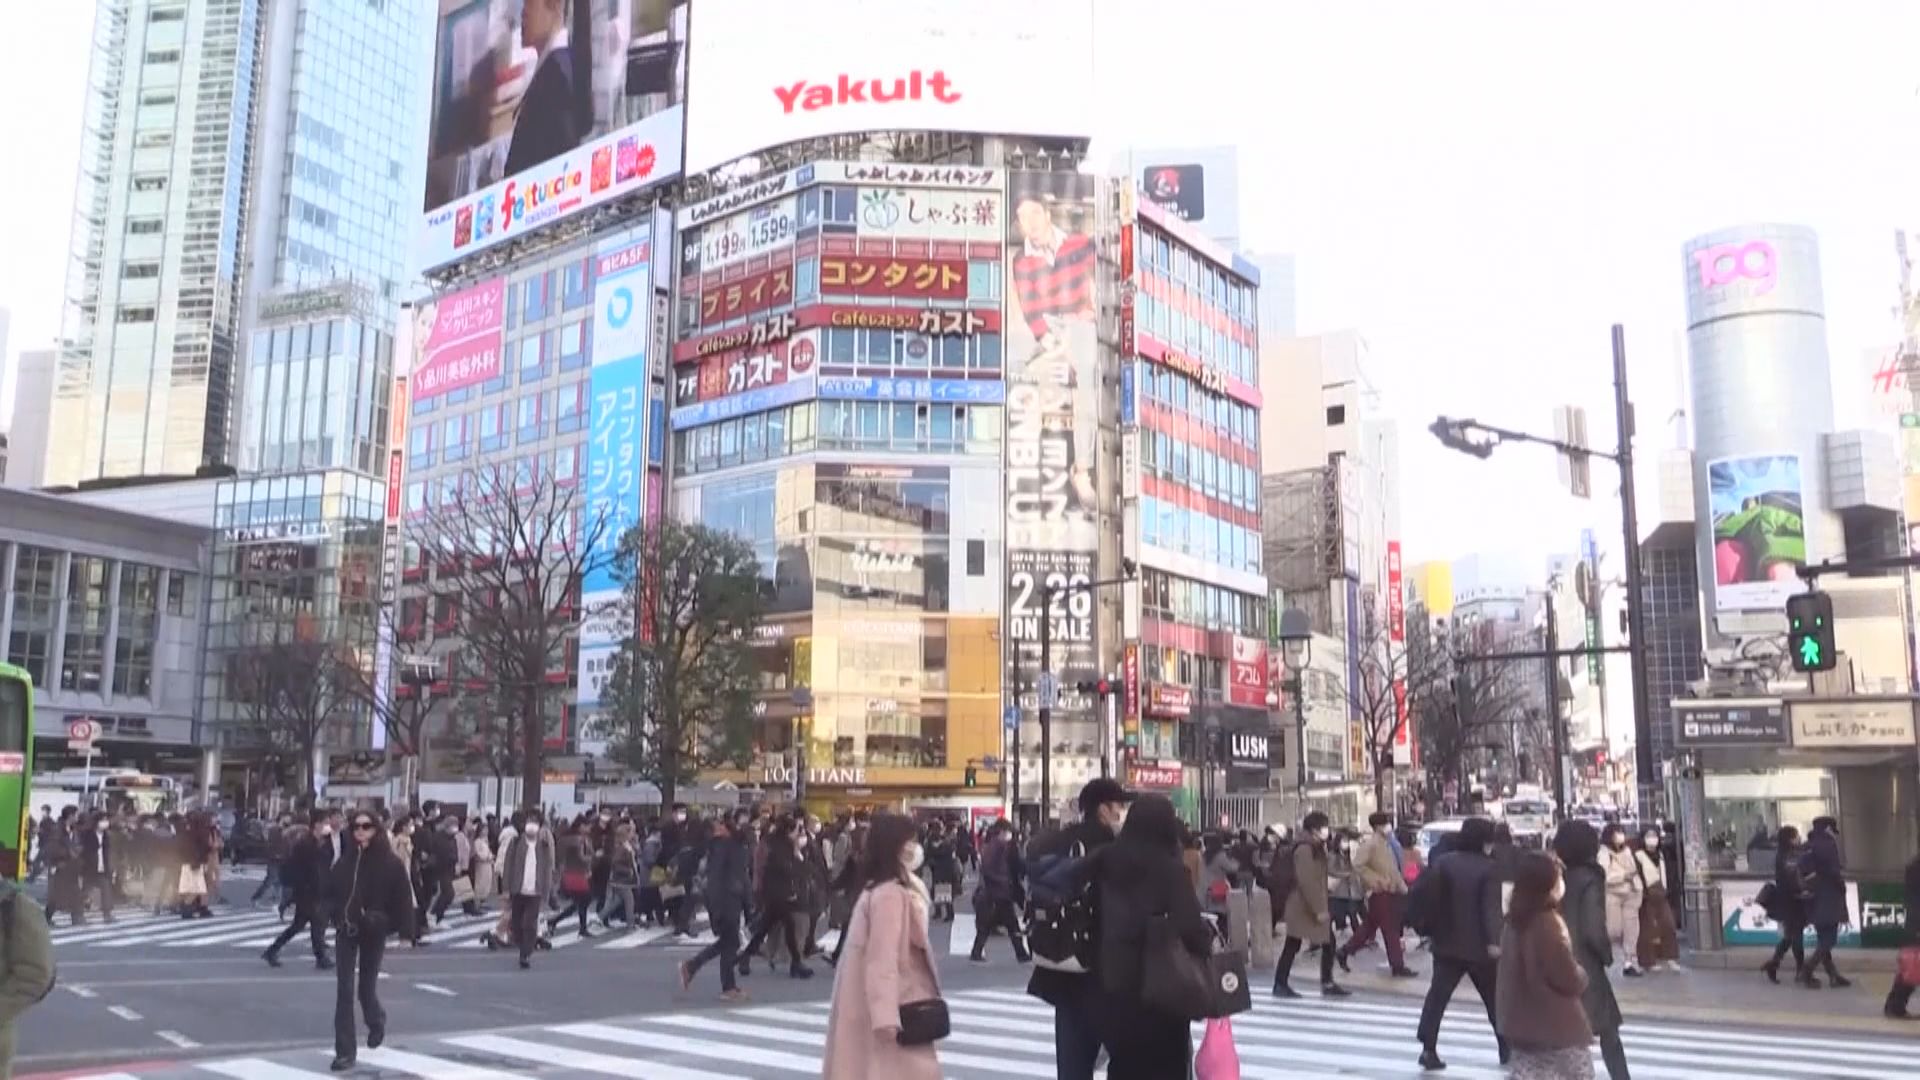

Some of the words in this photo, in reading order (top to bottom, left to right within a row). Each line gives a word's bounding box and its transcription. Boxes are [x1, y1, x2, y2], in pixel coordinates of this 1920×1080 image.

[773, 70, 962, 115] Yakult
[845, 165, 994, 185] しゃぶしゃぶバイキング
[908, 198, 996, 227] しゃぶ葉
[684, 244, 700, 262] 9F
[822, 261, 962, 291] コンタクト
[1694, 240, 1777, 296] 109
[703, 270, 790, 319] プライス
[751, 314, 796, 345] ガスト
[919, 310, 985, 335] ガスト
[728, 351, 783, 394] ガスト
[679, 376, 697, 398] 7F
[1010, 572, 1092, 618] 2.26
[1010, 617, 1038, 640] ON
[1048, 617, 1092, 641] SALE
[1237, 664, 1261, 686] アコム
[1232, 734, 1268, 759] LUSH
[764, 768, 866, 784] L'OCITANE
